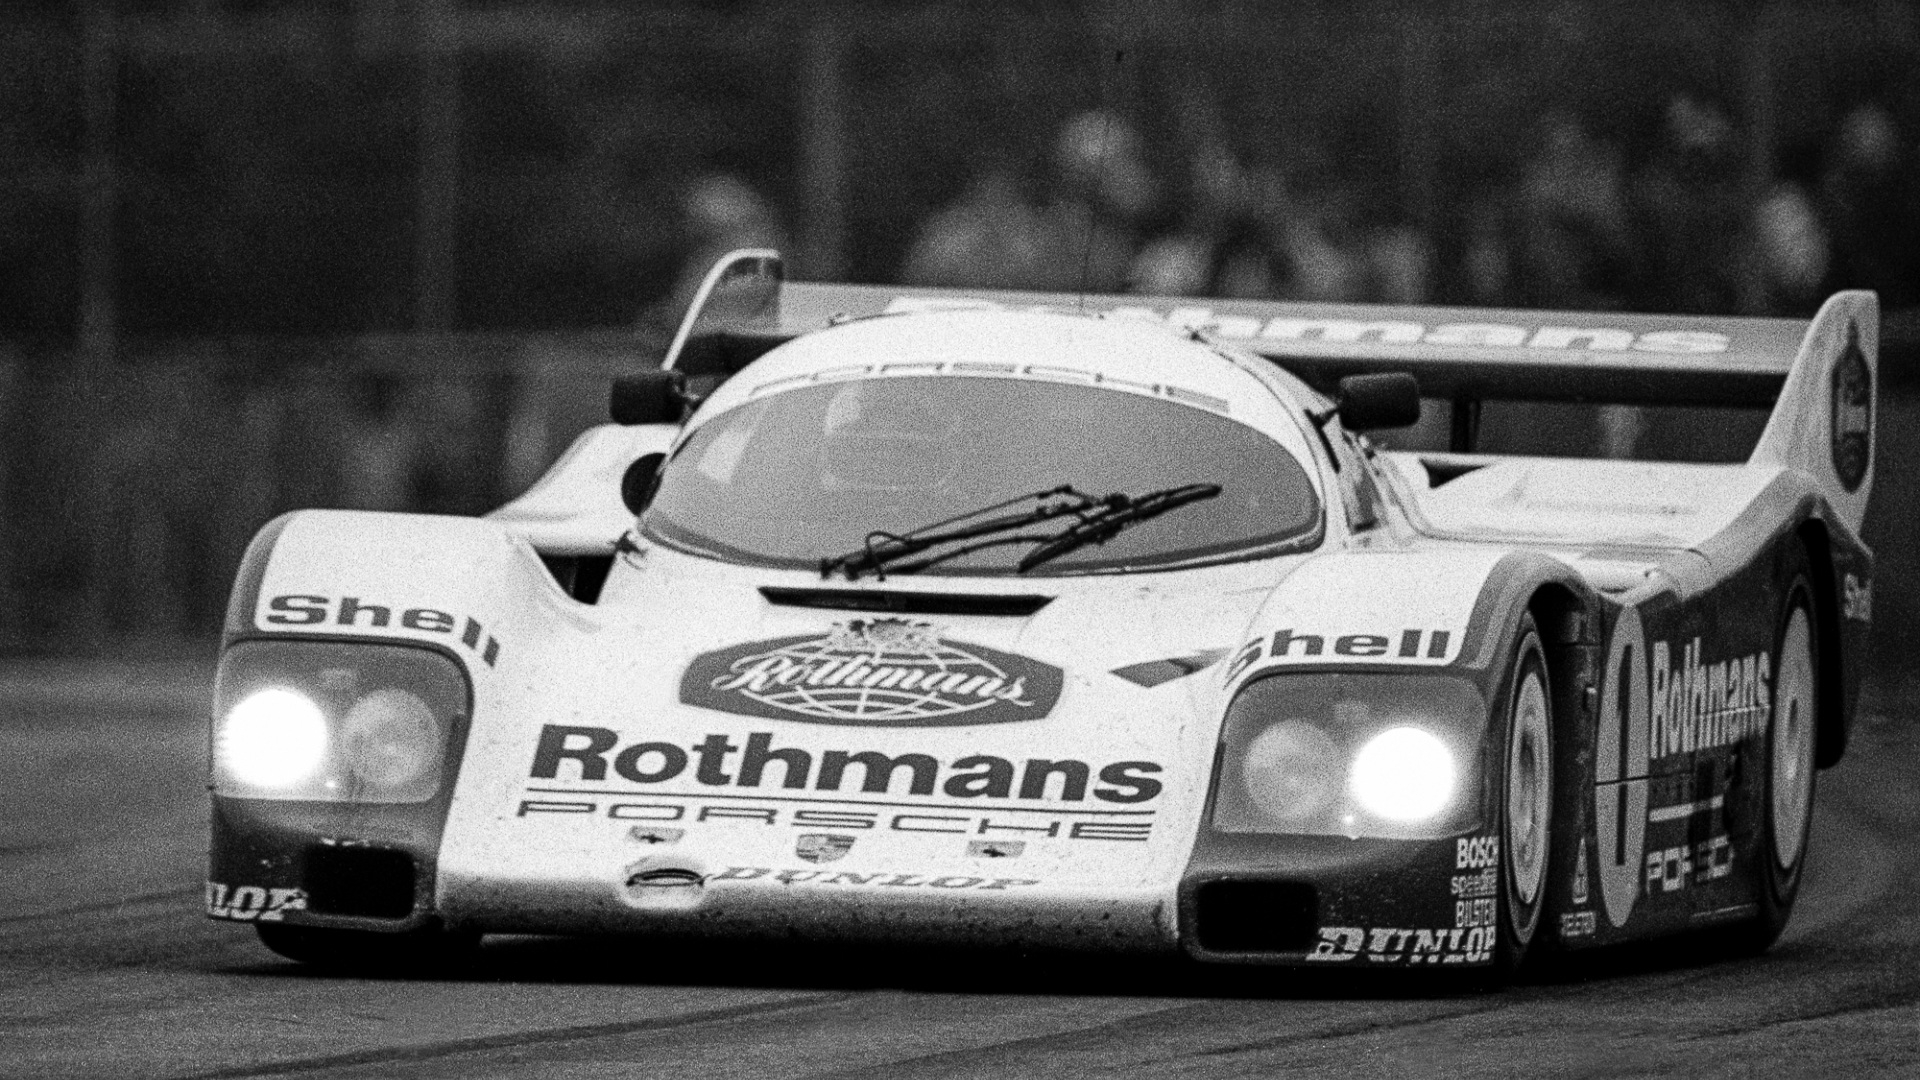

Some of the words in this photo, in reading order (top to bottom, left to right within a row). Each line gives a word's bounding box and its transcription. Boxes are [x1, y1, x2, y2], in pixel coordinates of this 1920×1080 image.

[1110, 305, 1728, 355] hmans
[266, 595, 500, 668] Shell
[711, 655, 1036, 706] Rothmans
[1223, 629, 1451, 691] Shell
[1649, 636, 1771, 759] Rothmans
[530, 724, 1163, 803] Rothmans
[517, 800, 1153, 841] PORSCHE
[703, 866, 1040, 889] DUNLOP
[1305, 927, 1496, 963] DUNLOP
